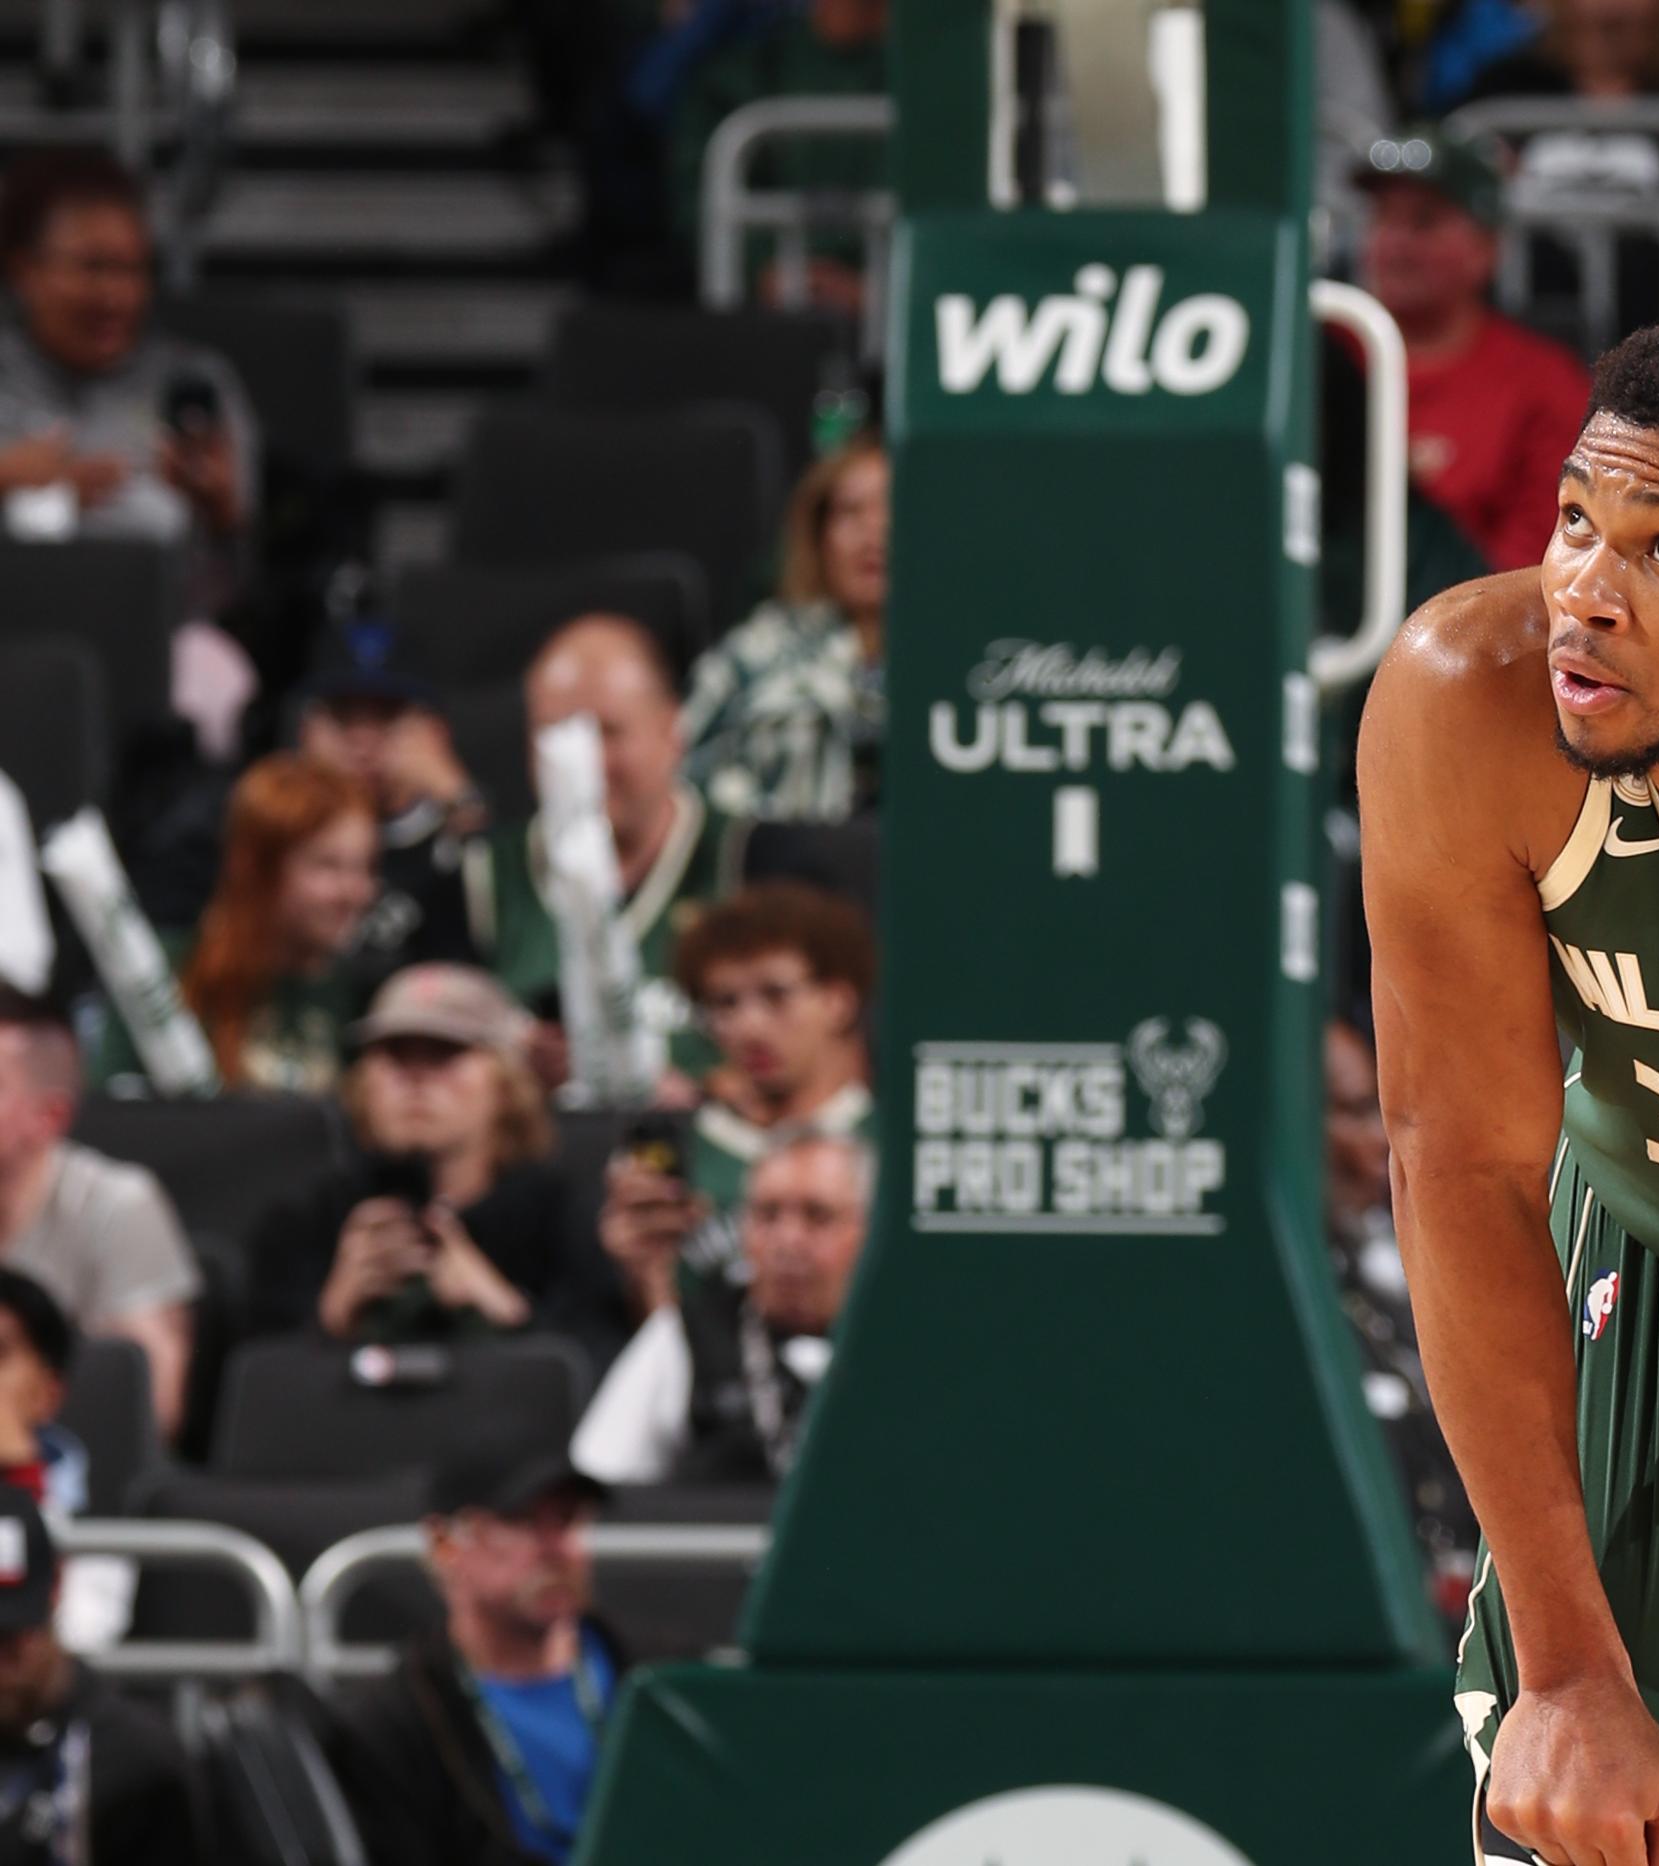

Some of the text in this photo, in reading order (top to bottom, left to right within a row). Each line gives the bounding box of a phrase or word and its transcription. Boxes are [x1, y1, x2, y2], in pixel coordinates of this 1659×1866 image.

[934, 262, 1250, 396] wilo
[929, 701, 1236, 773] ULTRA
[914, 1060, 1126, 1138] BUCKS
[914, 1138, 1226, 1213] PRO SHOP
